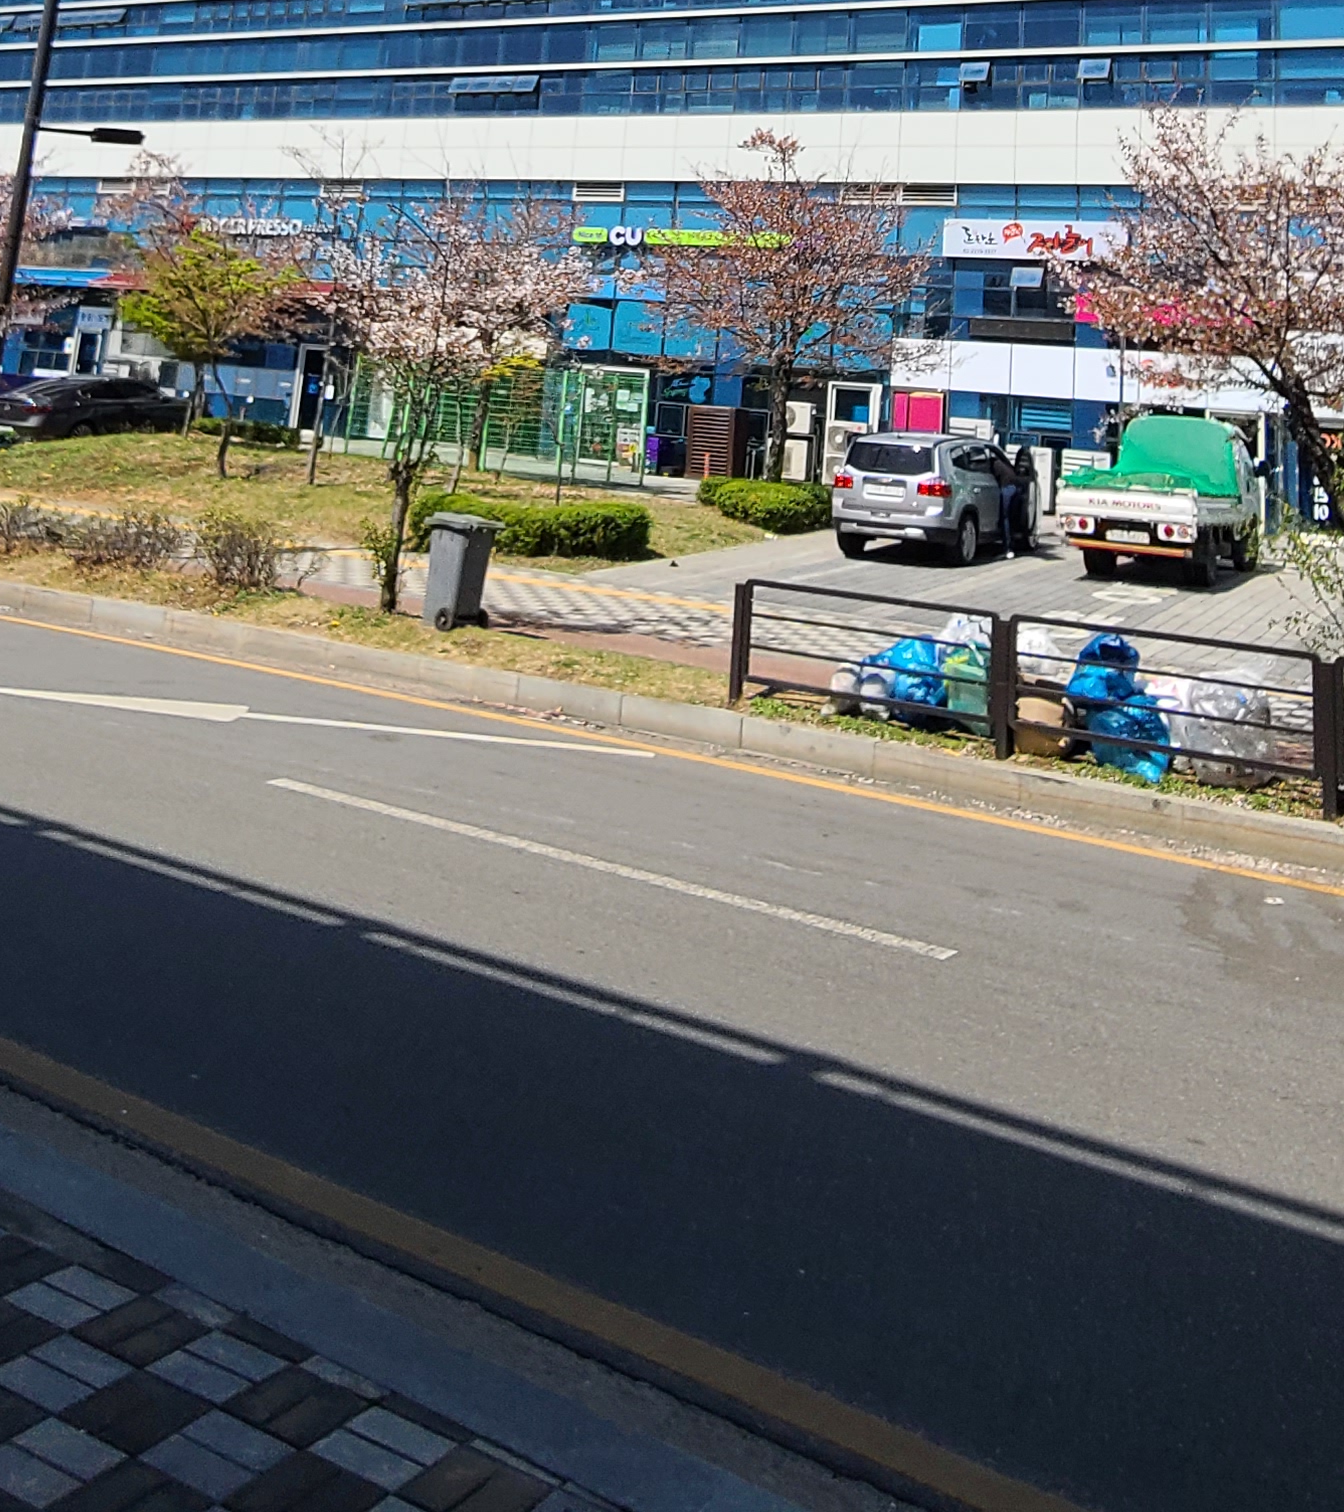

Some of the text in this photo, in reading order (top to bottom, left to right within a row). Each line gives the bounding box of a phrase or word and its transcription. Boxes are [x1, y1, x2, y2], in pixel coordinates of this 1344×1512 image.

[609, 226, 642, 246] CU
[1088, 497, 1161, 512] KIA MOTORS
